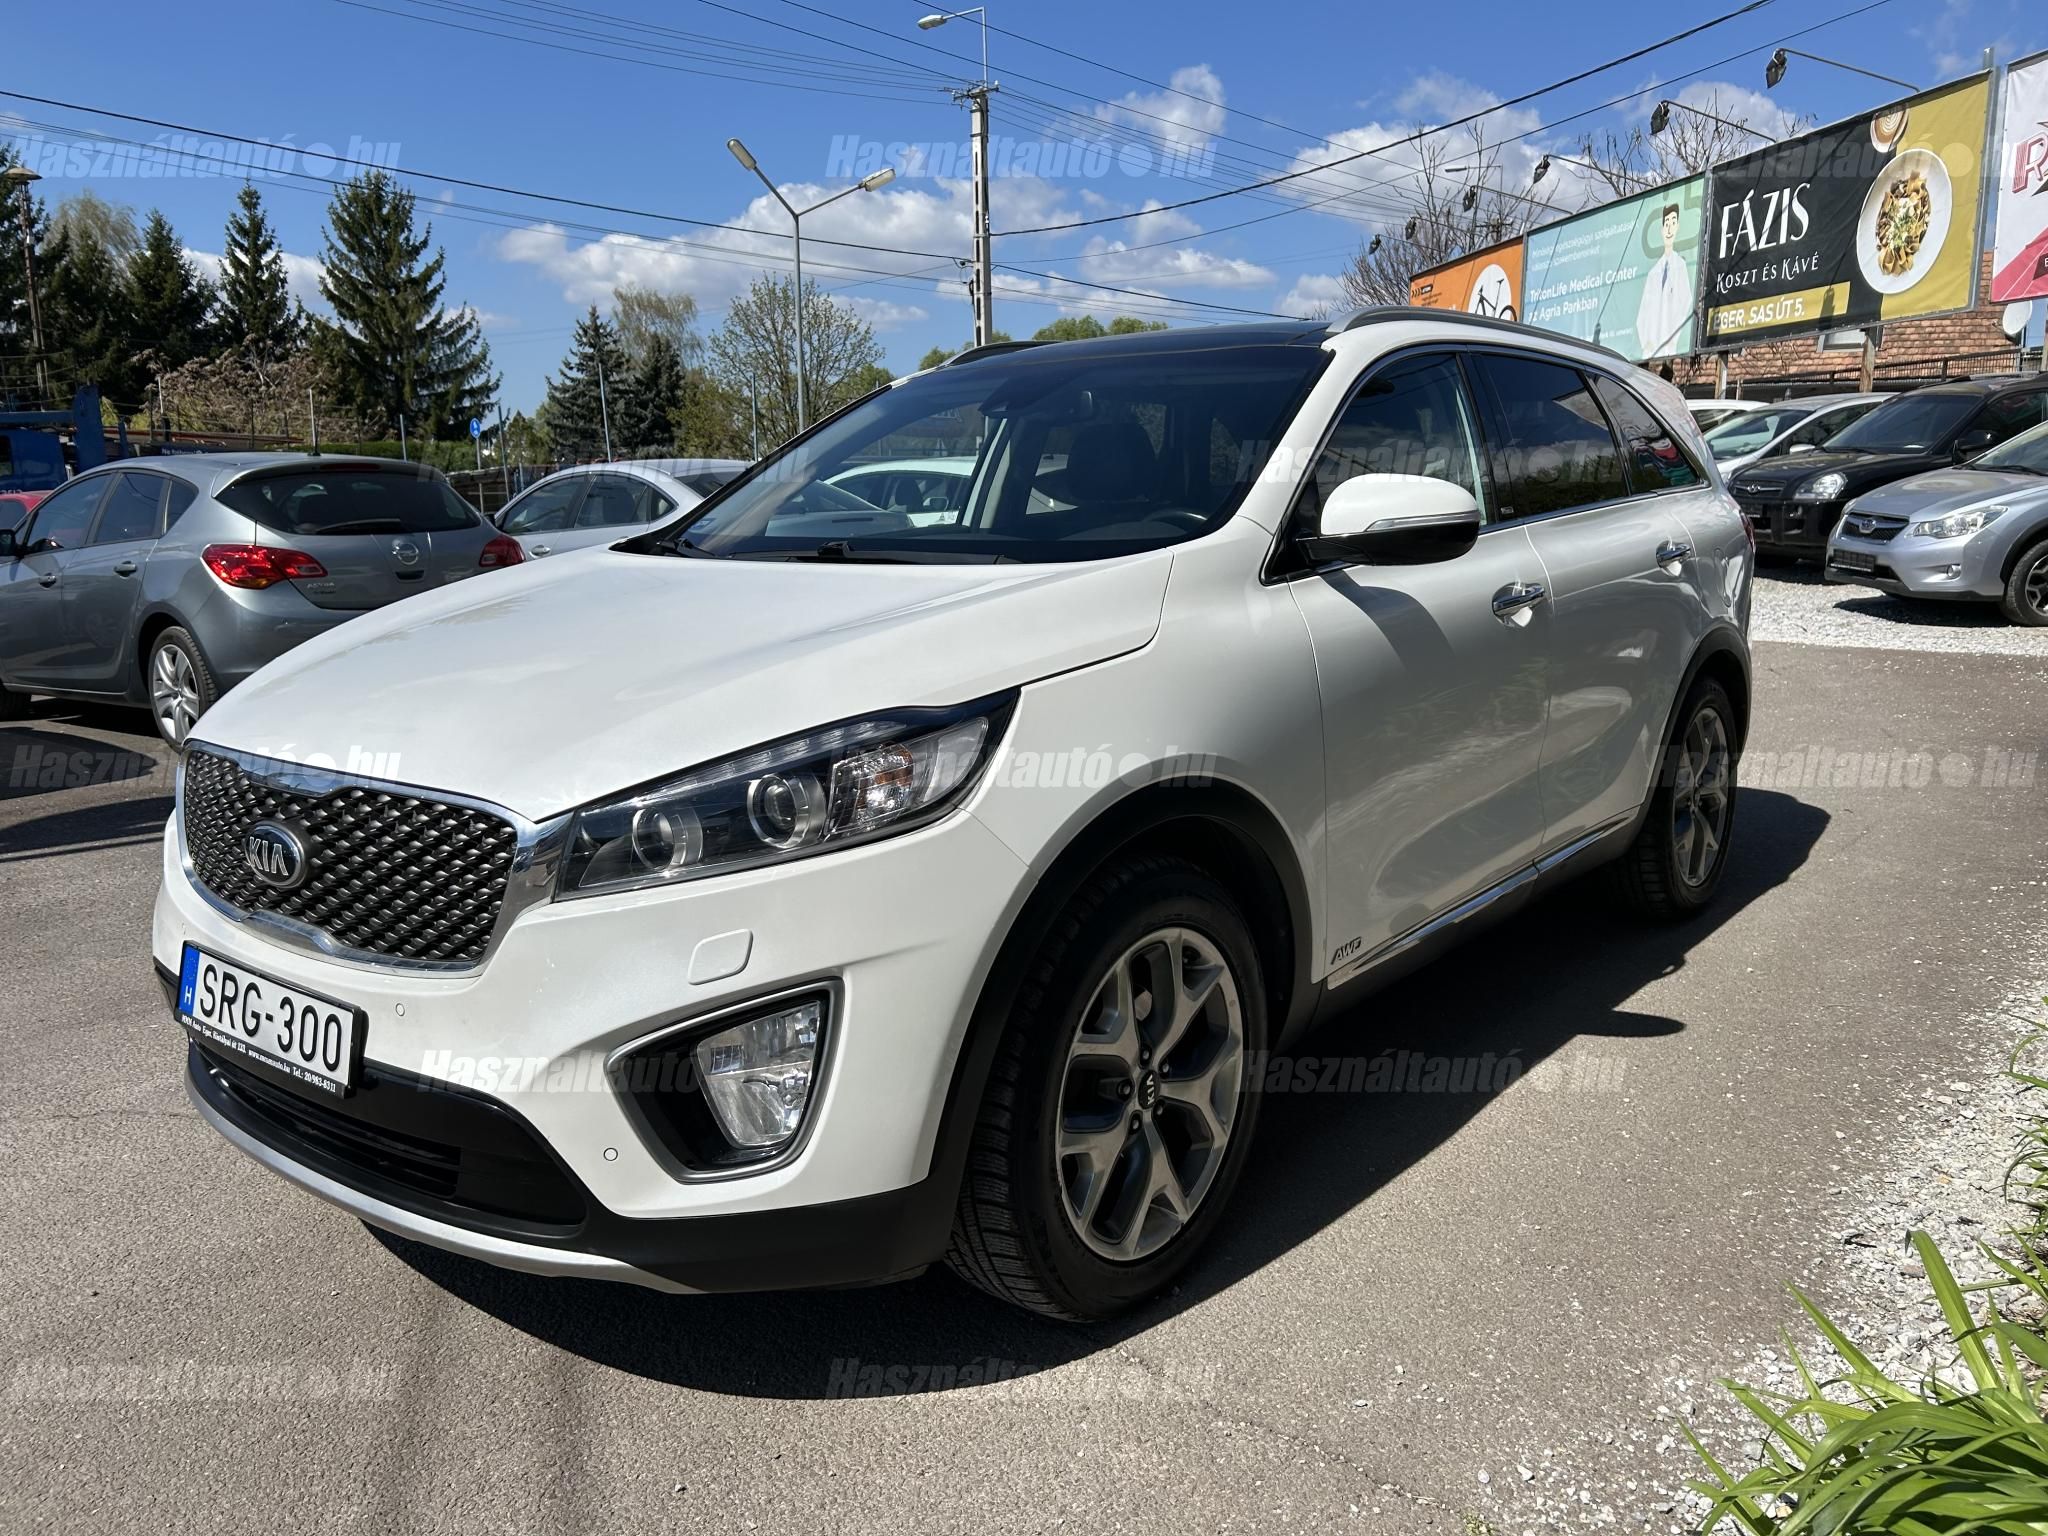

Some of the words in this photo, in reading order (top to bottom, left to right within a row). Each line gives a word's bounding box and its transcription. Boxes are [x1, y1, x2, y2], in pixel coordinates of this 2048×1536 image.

[1719, 182, 1811, 259] FÁZIS
[1569, 272, 1603, 293] Medical
[1605, 267, 1638, 285] Center
[1539, 304, 1561, 322] Agria
[1562, 297, 1599, 315] Parkban
[1748, 303, 1774, 325] SAS
[1775, 296, 1794, 321] ÚT
[249, 836, 289, 877] KIA
[184, 986, 193, 1006] H
[199, 963, 342, 1072] SRG-300
